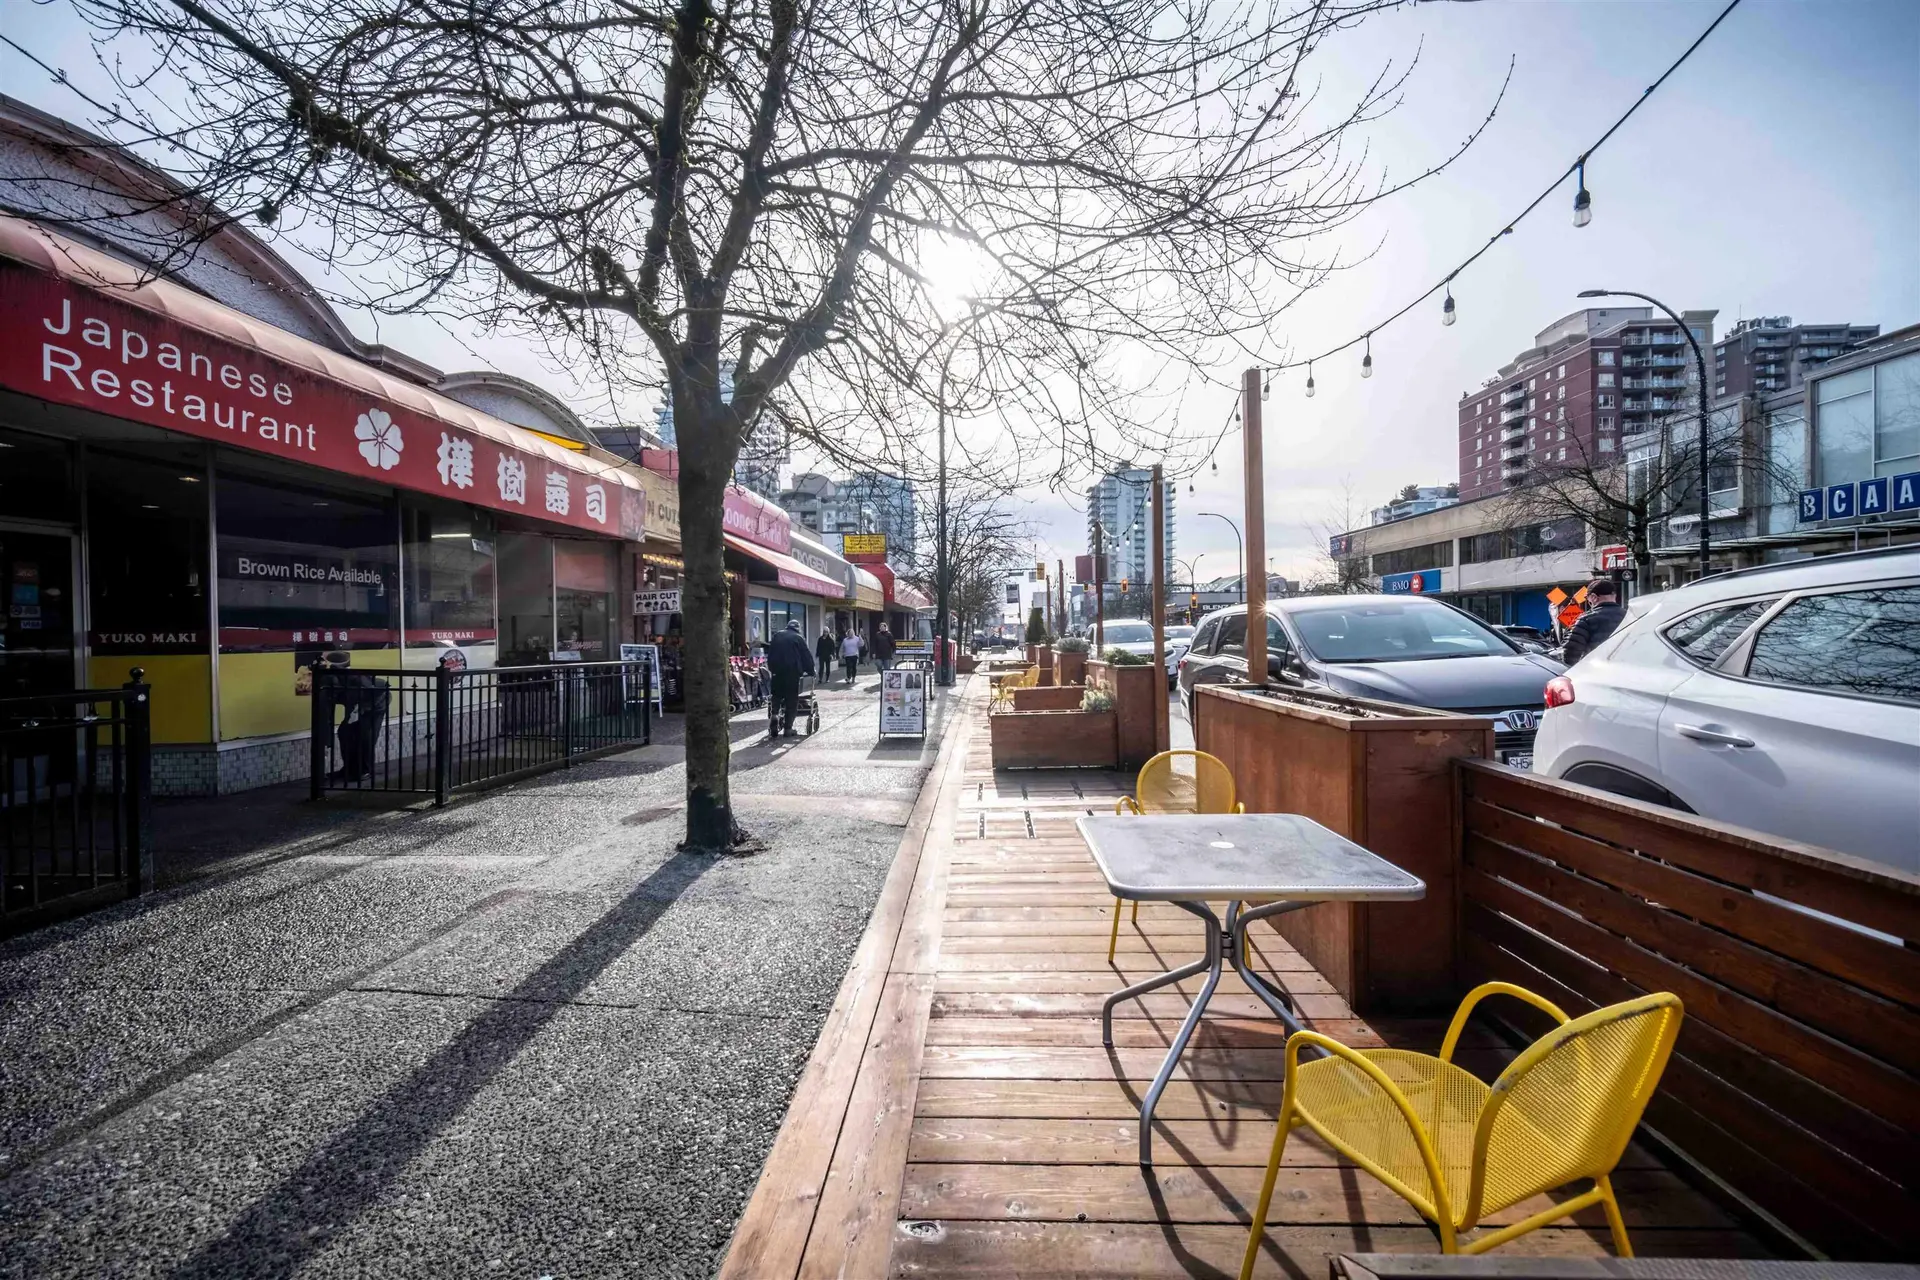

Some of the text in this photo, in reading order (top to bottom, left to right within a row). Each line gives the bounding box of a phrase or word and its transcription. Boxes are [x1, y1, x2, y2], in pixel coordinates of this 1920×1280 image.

[42, 298, 294, 406] Japanese
[41, 342, 318, 452] Restaurant
[1803, 478, 1915, 518] BCAA
[658, 504, 680, 525] CUT
[722, 506, 758, 534] ooney
[238, 557, 381, 584] Brown Rice Available
[791, 547, 829, 574] OXYGEN
[635, 592, 678, 601] HAIR CUT
[1392, 580, 1409, 591] BMO
[98, 633, 197, 644] YUKO MAKI
